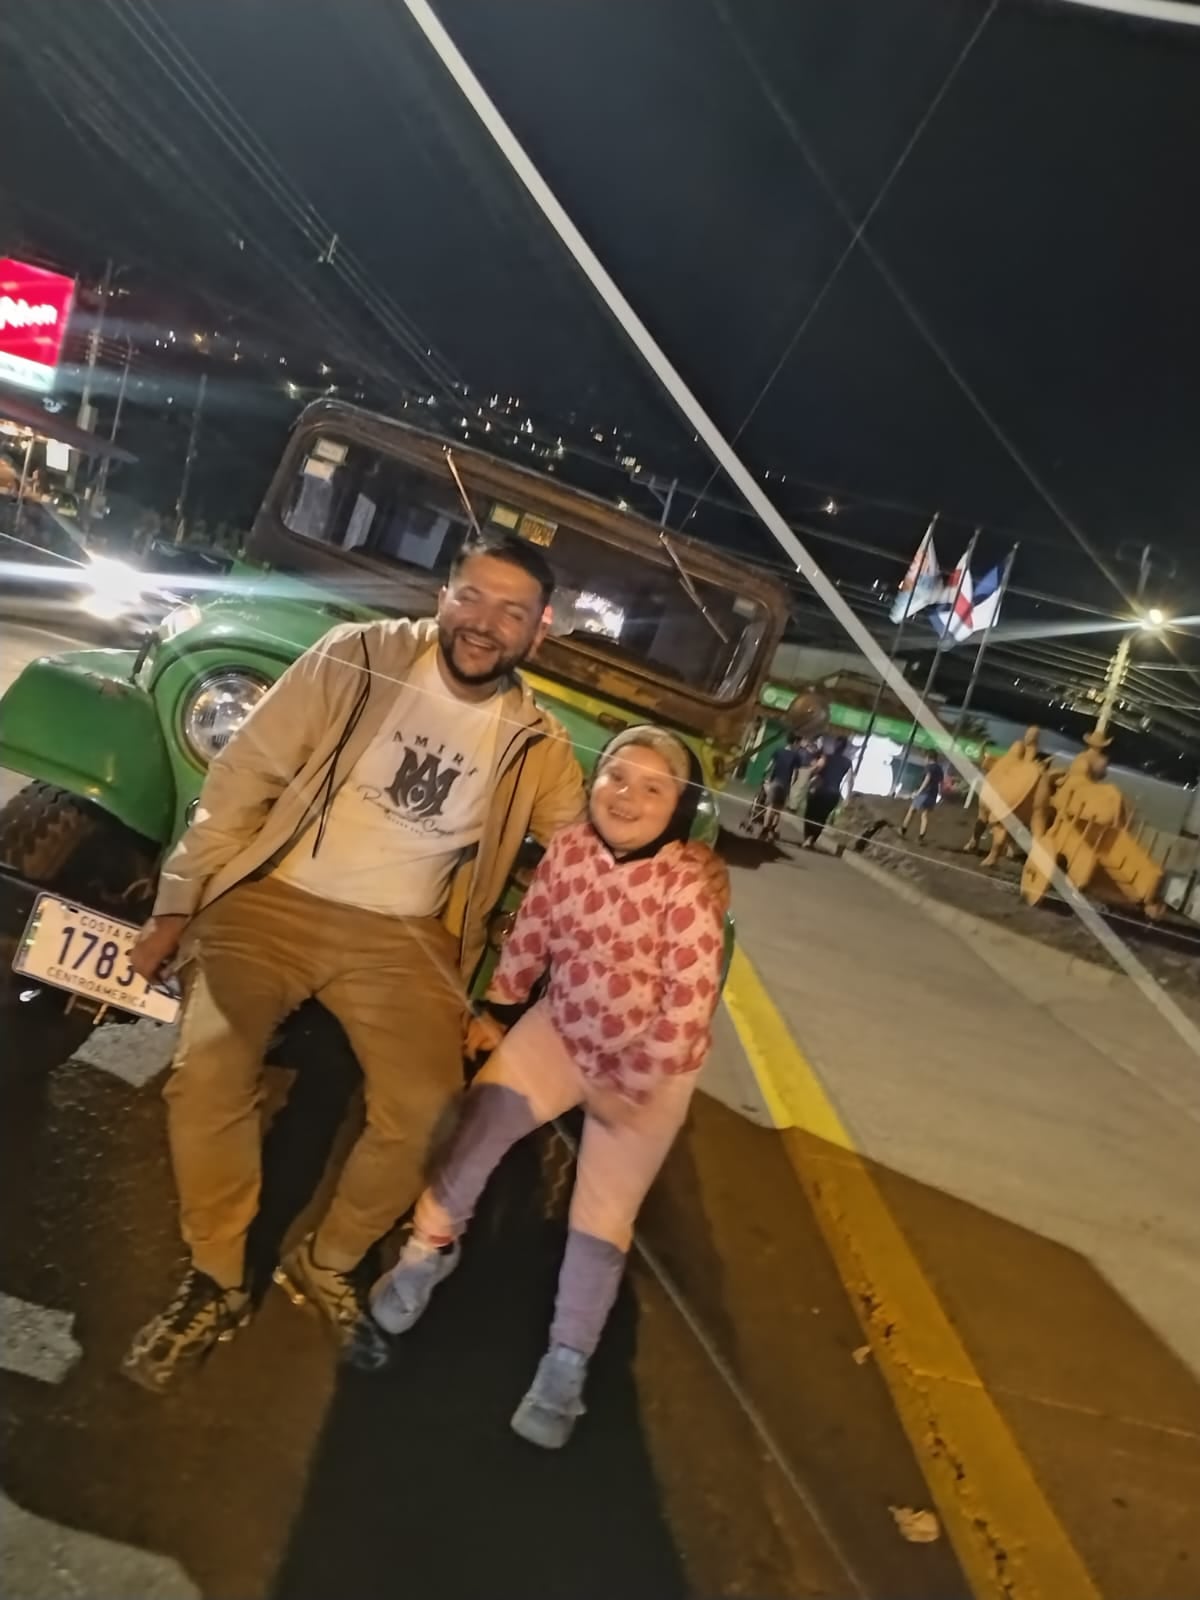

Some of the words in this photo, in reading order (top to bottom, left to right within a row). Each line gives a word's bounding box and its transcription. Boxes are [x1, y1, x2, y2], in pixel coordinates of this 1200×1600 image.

[80, 915, 119, 937] COSTA
[57, 926, 151, 994] 1783
[46, 966, 147, 1008] CENTROAMERICA
